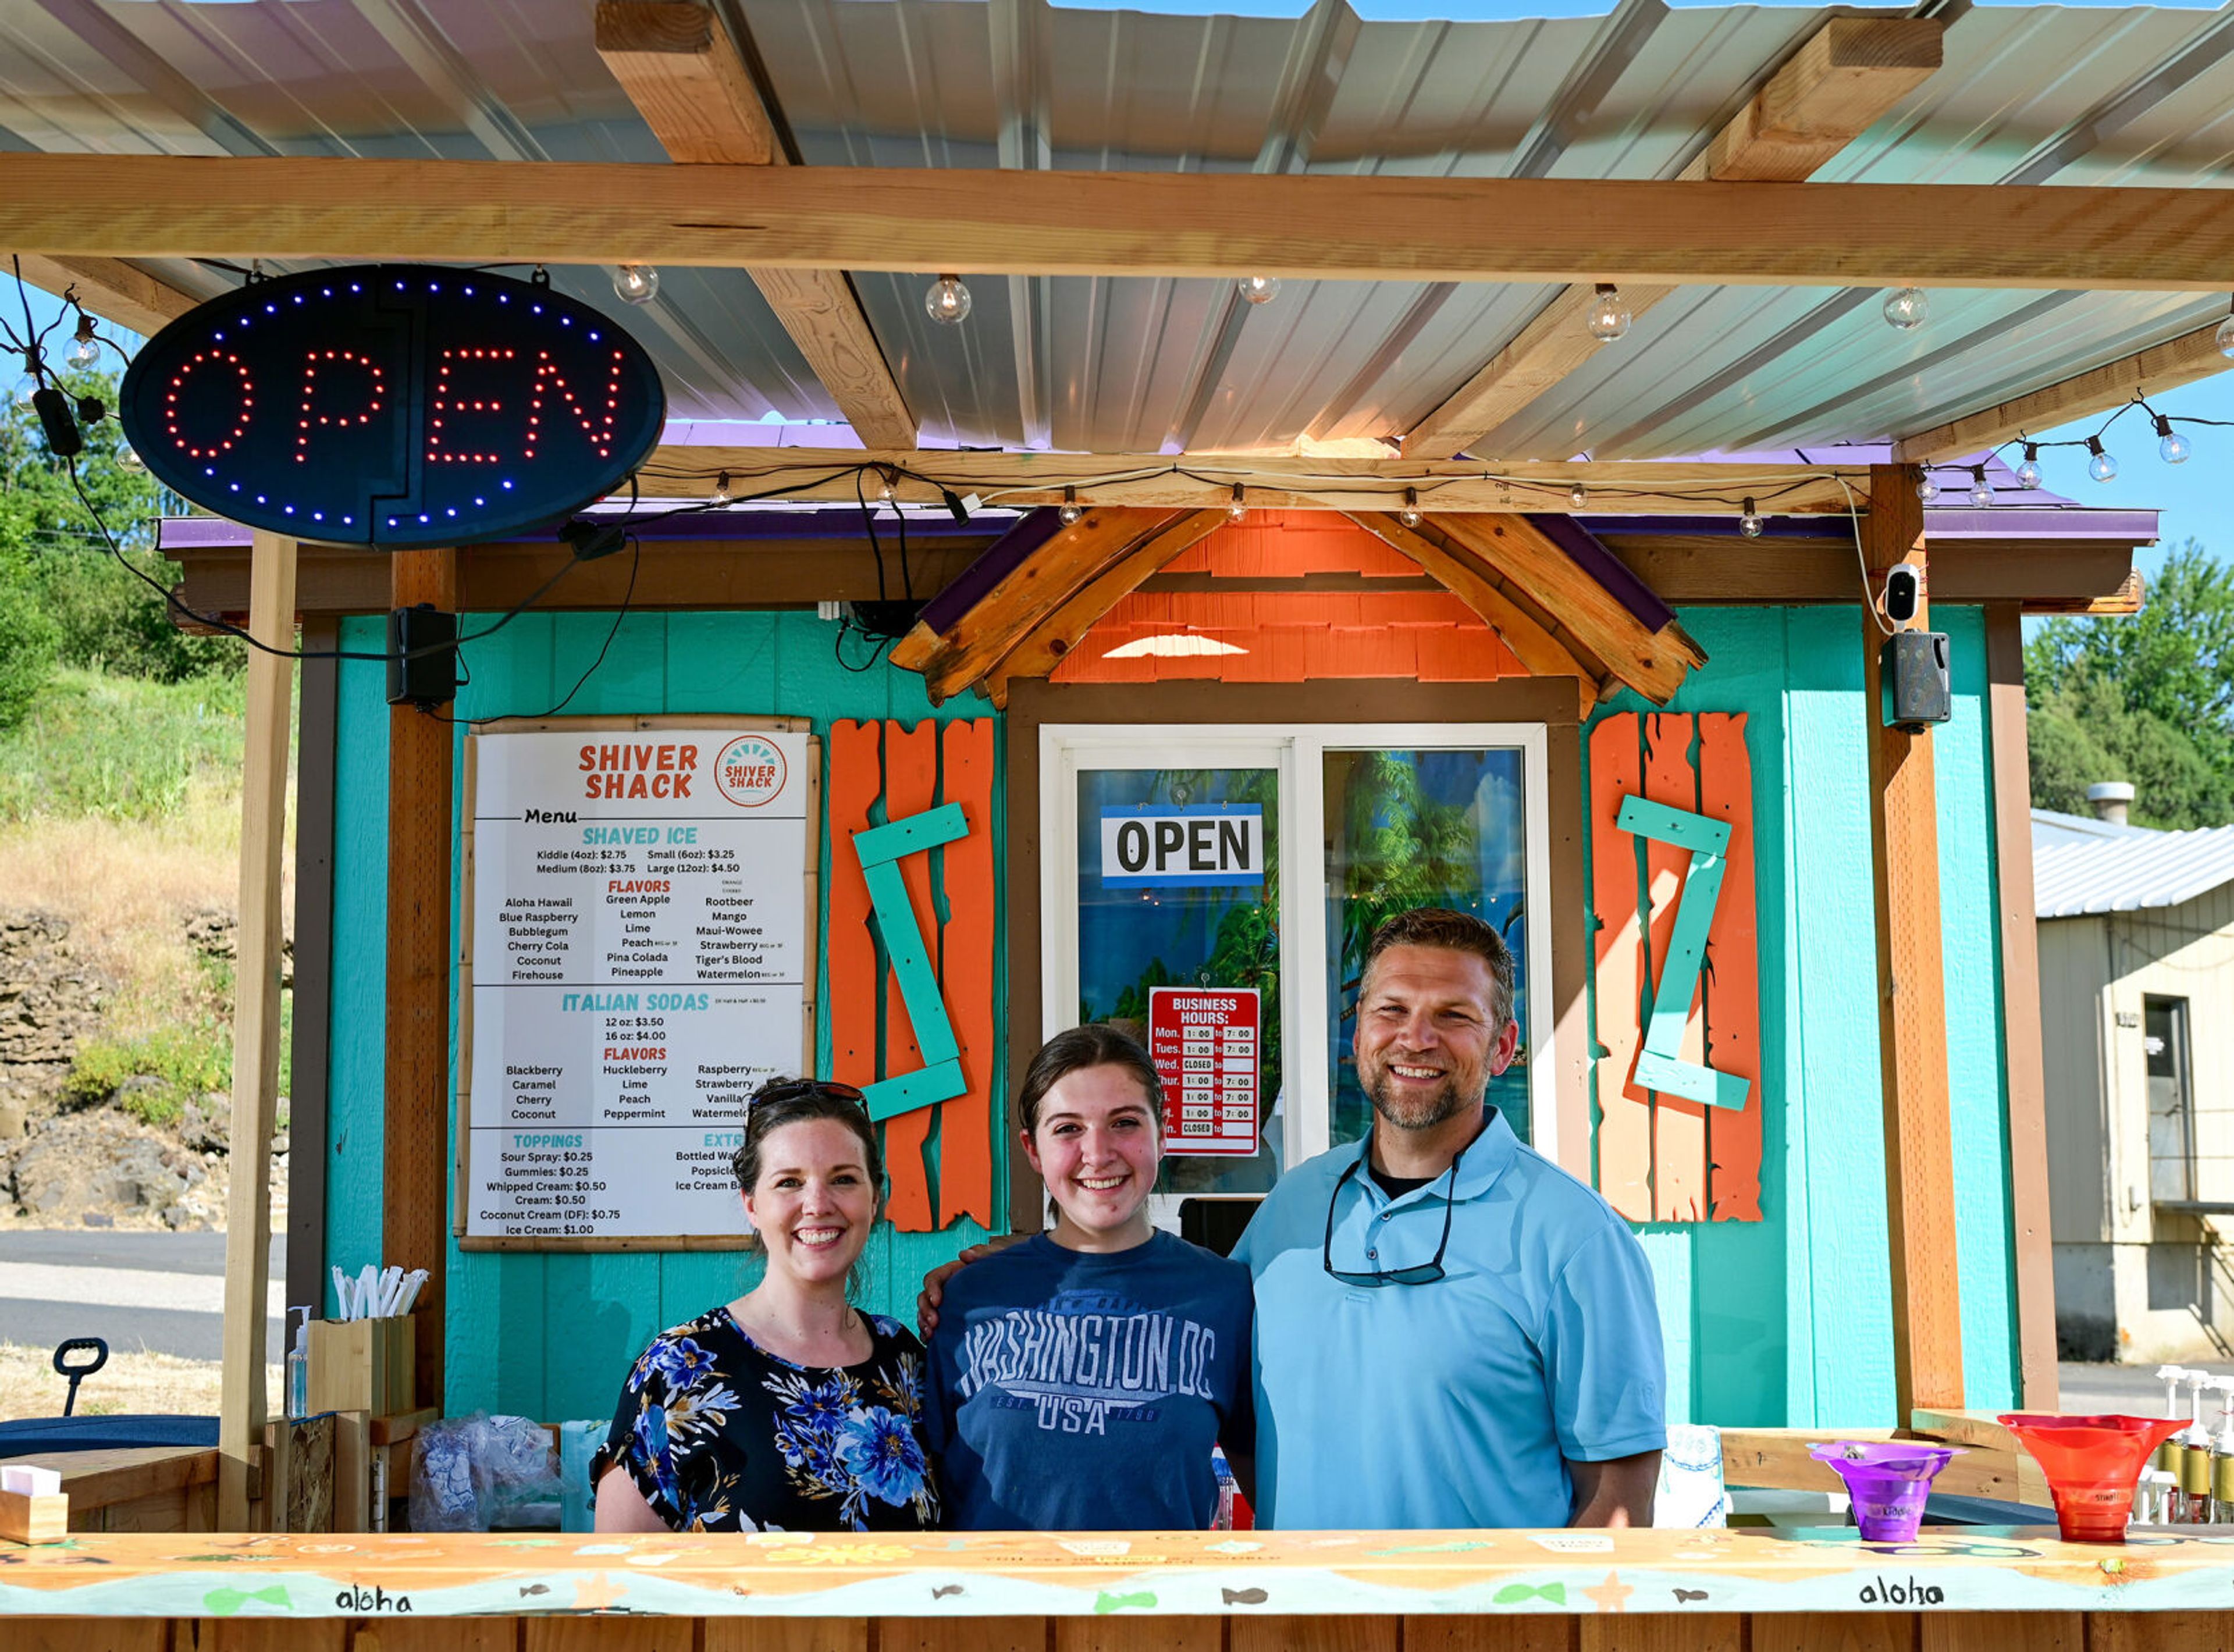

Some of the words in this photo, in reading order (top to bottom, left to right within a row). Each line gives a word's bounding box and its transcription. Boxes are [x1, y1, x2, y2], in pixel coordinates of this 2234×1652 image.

[165, 350, 622, 463] OPEN
[579, 745, 698, 771] SHIVER
[725, 766, 776, 777] SHIVER
[586, 774, 692, 799] SHACK
[729, 777, 773, 788] SHACK
[525, 809, 577, 823] Menu
[582, 827, 659, 845] SHAVED
[667, 827, 698, 844] ICE
[1117, 820, 1250, 872] OPEN
[538, 850, 568, 859] Kiddie
[601, 850, 627, 859] $2.75
[648, 850, 675, 859] Small
[708, 849, 734, 859] $3.25
[537, 864, 577, 873] Medium
[609, 864, 635, 873] $3.75
[648, 865, 674, 874] Large
[712, 863, 739, 873] $4.50
[609, 880, 670, 893] FLAVORS
[506, 898, 535, 907] Aloha
[538, 898, 572, 906] Hawaii
[606, 895, 637, 904] Green
[640, 895, 670, 905] Apple
[706, 898, 753, 906] Rootbeer
[500, 913, 522, 921] Blue
[526, 913, 578, 924] Raspberry
[621, 910, 656, 918] Lemon
[713, 912, 746, 923] Mango
[509, 927, 568, 938] Bubblegum
[626, 924, 650, 932] Lime
[696, 926, 762, 935] Maui-Wowee
[508, 942, 543, 952] Cherry
[546, 942, 568, 950] Cola
[622, 938, 653, 947] Peach
[700, 941, 757, 952] Strawberry
[517, 956, 561, 965] Coconut
[607, 953, 629, 962] Pina
[632, 953, 668, 962] Colada
[732, 955, 762, 964] Blood
[513, 970, 563, 980] Firehouse
[611, 967, 663, 978] Pineapple
[697, 970, 760, 978] Watermelon
[562, 994, 638, 1012] ITALIAN
[646, 993, 709, 1011] SODAS
[1173, 998, 1237, 1011] BUSINESS
[606, 1018, 617, 1026] 12
[636, 1017, 664, 1027] $3.50
[1181, 1012, 1229, 1024] HOURS:
[606, 1032, 617, 1040] 16
[636, 1031, 666, 1041] $4.00
[1155, 1028, 1180, 1037] Mon.
[604, 1048, 666, 1060] FLAVORS
[1155, 1044, 1180, 1053] Tues.
[1155, 1060, 1179, 1069] Wed.
[507, 1066, 563, 1077] Blackberry
[603, 1065, 667, 1076] Huckleberry
[698, 1065, 751, 1076] Raspberry
[513, 1080, 556, 1090] Caramel
[623, 1080, 648, 1088] Lime
[696, 1080, 753, 1090] Strawberry
[517, 1095, 552, 1106] Cherry
[620, 1095, 650, 1103] Peach
[706, 1094, 742, 1103] Vanilla
[511, 1110, 556, 1119] Coconut
[604, 1109, 665, 1120] Peppermint
[692, 1109, 746, 1117] Watermelo
[514, 1135, 582, 1148] TOPPINGS
[704, 1134, 745, 1147] EXTR
[501, 1153, 525, 1162] Sour
[528, 1153, 561, 1163] Spray:
[564, 1152, 592, 1162] $0.25
[676, 1152, 715, 1160] Bottled
[505, 1167, 556, 1176] Gummies:
[560, 1166, 588, 1177] $0.25
[691, 1166, 735, 1177] Popsicle
[487, 1182, 533, 1193] Whipped
[536, 1182, 572, 1191] Cream:
[575, 1181, 606, 1192] $0.50
[675, 1181, 691, 1190] Ice
[693, 1181, 727, 1190] Cream
[515, 1196, 552, 1204] Cream:
[555, 1195, 585, 1205] $0.50
[481, 1210, 525, 1219] Coconut
[527, 1210, 561, 1219] Cream
[592, 1209, 620, 1220] $0.75
[506, 1226, 521, 1234] Ice
[524, 1226, 561, 1234] Cream:
[564, 1224, 593, 1234] $1.00
[961, 1311, 1173, 1397] WASHINGTON
[1179, 1320, 1215, 1398] DC
[1038, 1394, 1105, 1436] USA
[1859, 1575, 1944, 1605] aloha
[335, 1583, 412, 1613] aloha
